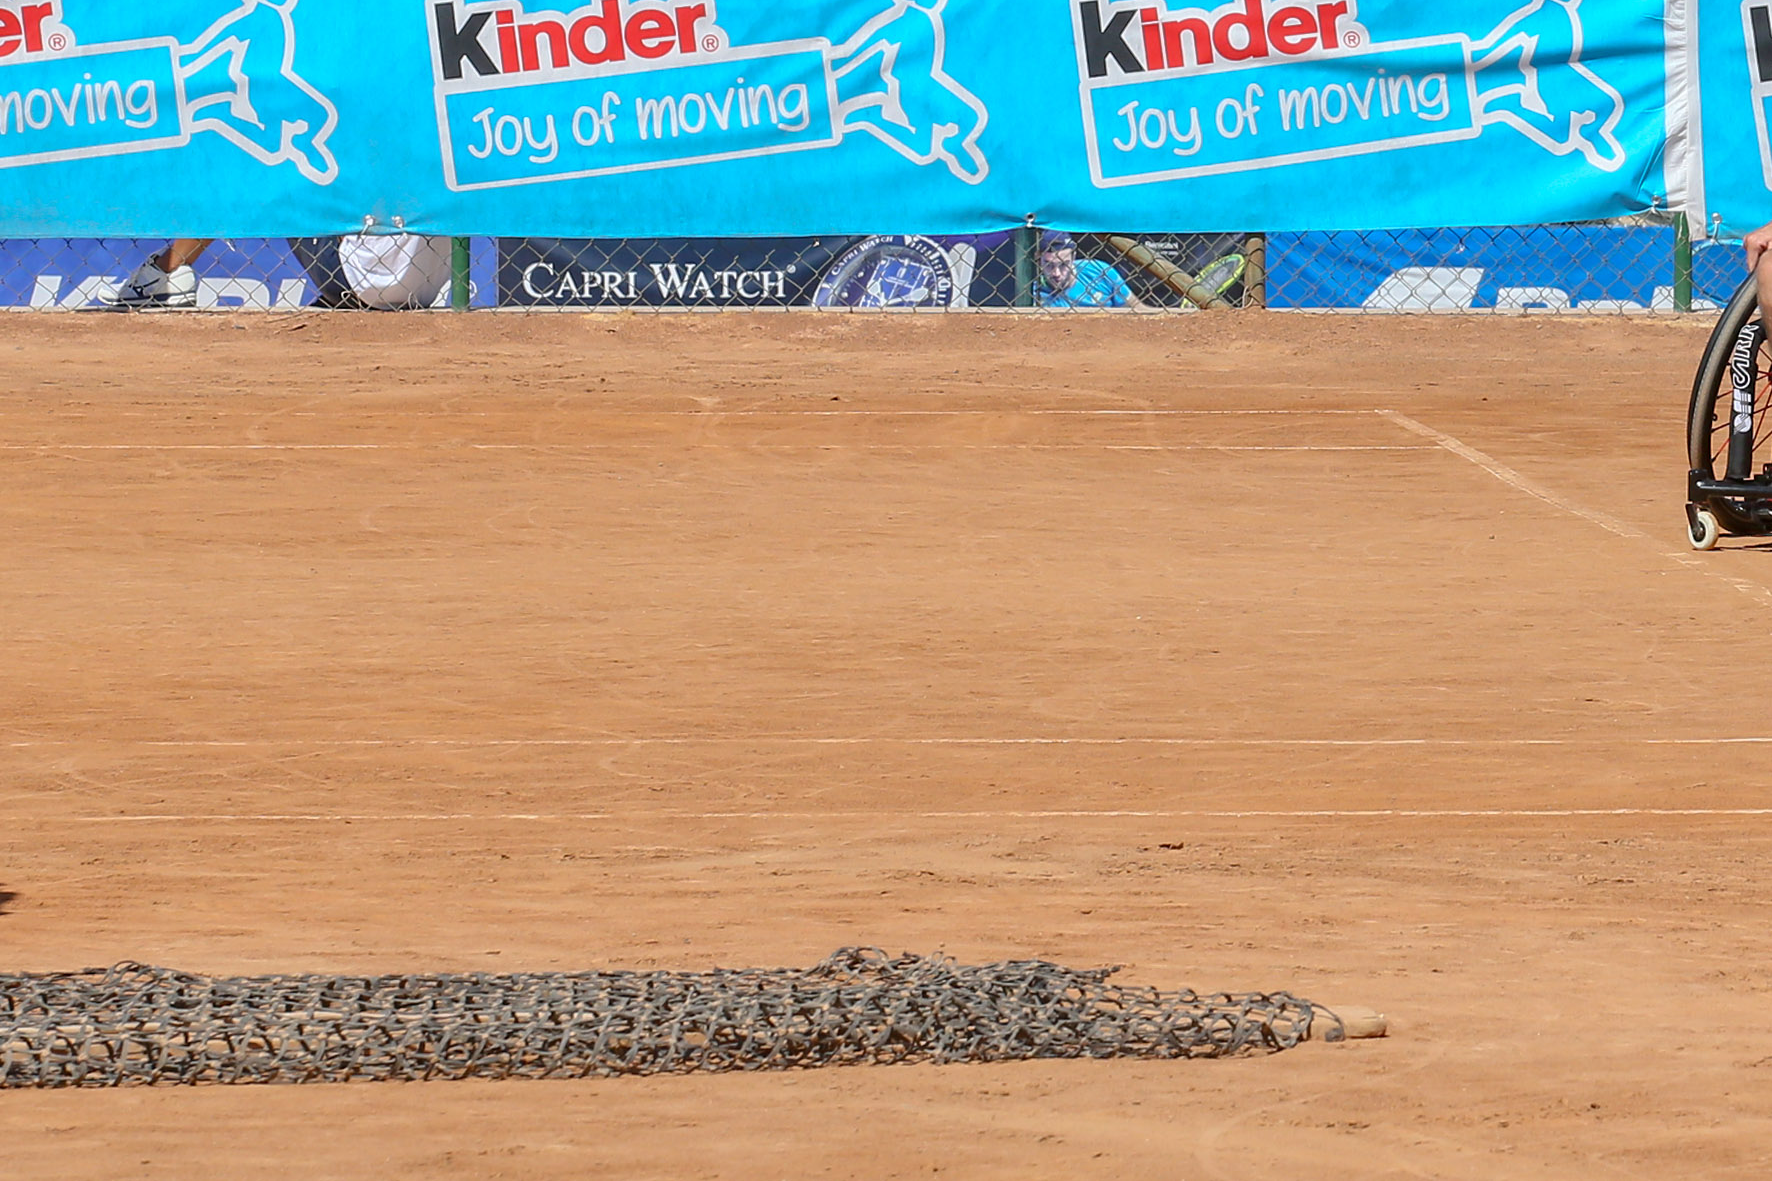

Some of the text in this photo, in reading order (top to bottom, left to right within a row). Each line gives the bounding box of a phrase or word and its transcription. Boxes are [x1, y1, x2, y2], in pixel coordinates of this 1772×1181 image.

[467, 76, 810, 164] Joy of moving
[1112, 68, 1450, 156] Joy of moving
